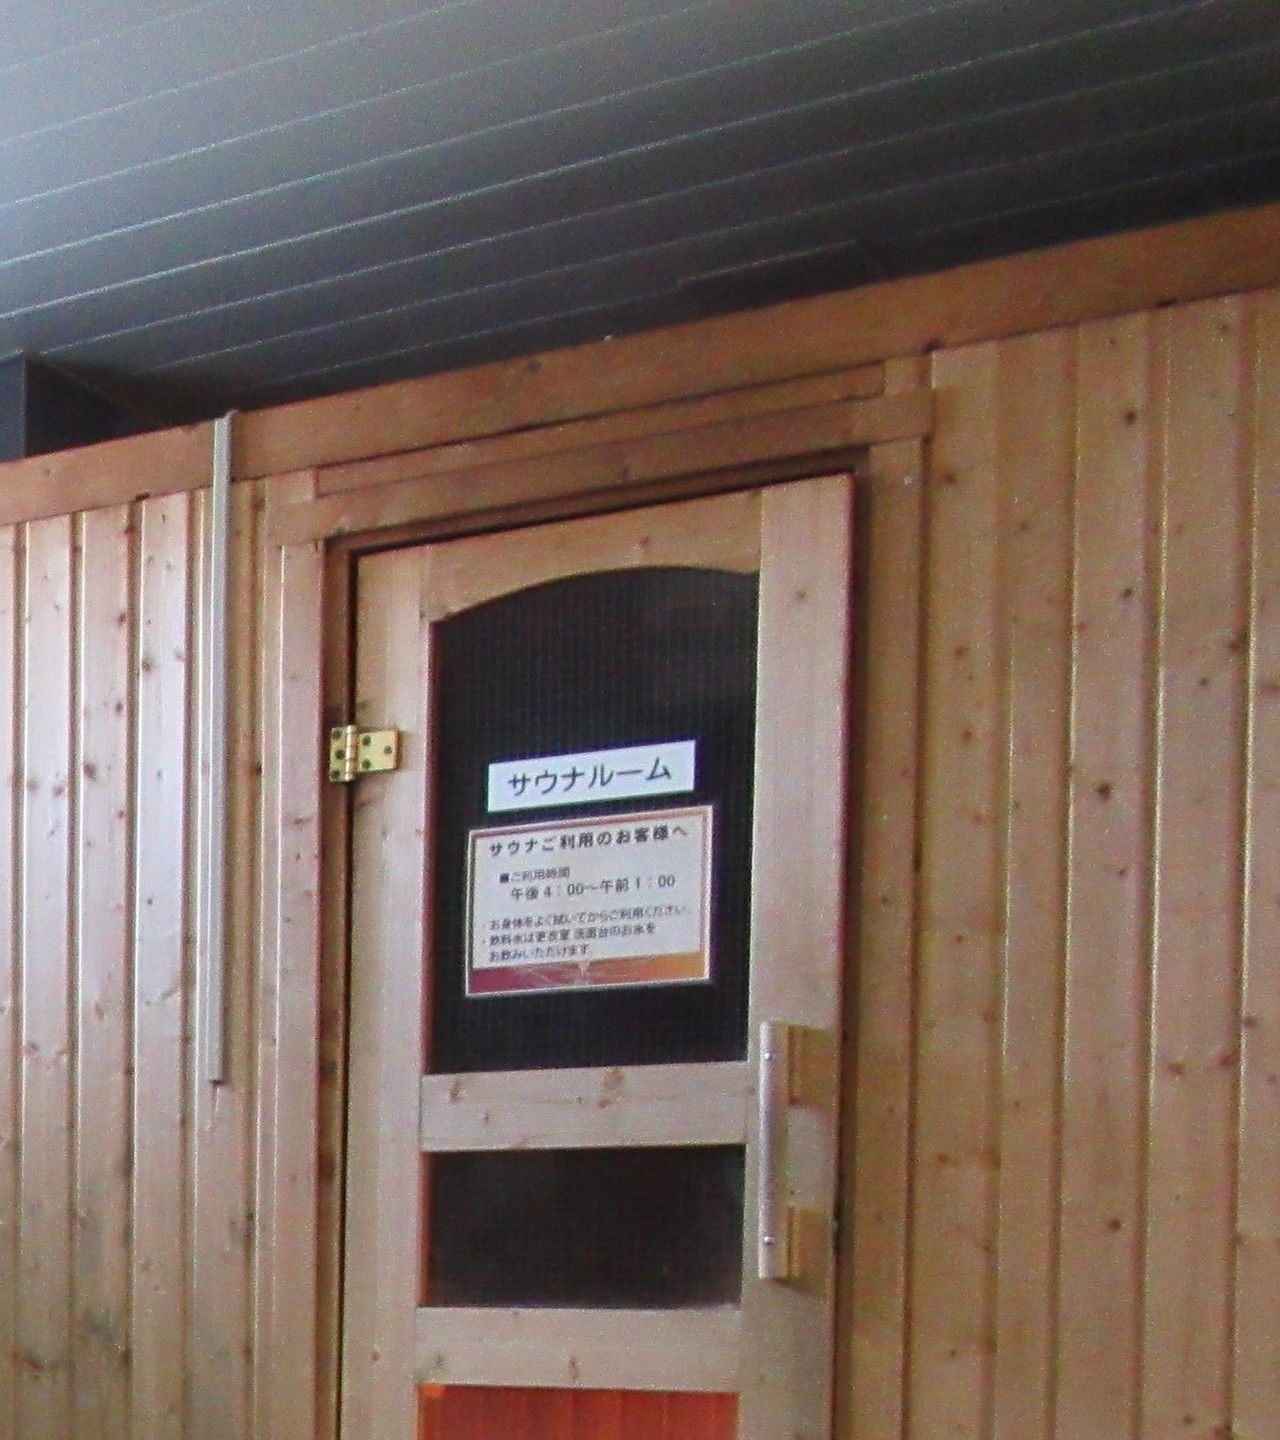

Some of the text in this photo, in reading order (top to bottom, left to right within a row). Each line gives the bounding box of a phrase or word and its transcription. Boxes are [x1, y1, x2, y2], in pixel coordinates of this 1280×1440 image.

[508, 756, 672, 796] サウナルーム
[490, 825, 688, 856] サウナご利用のお客様へ
